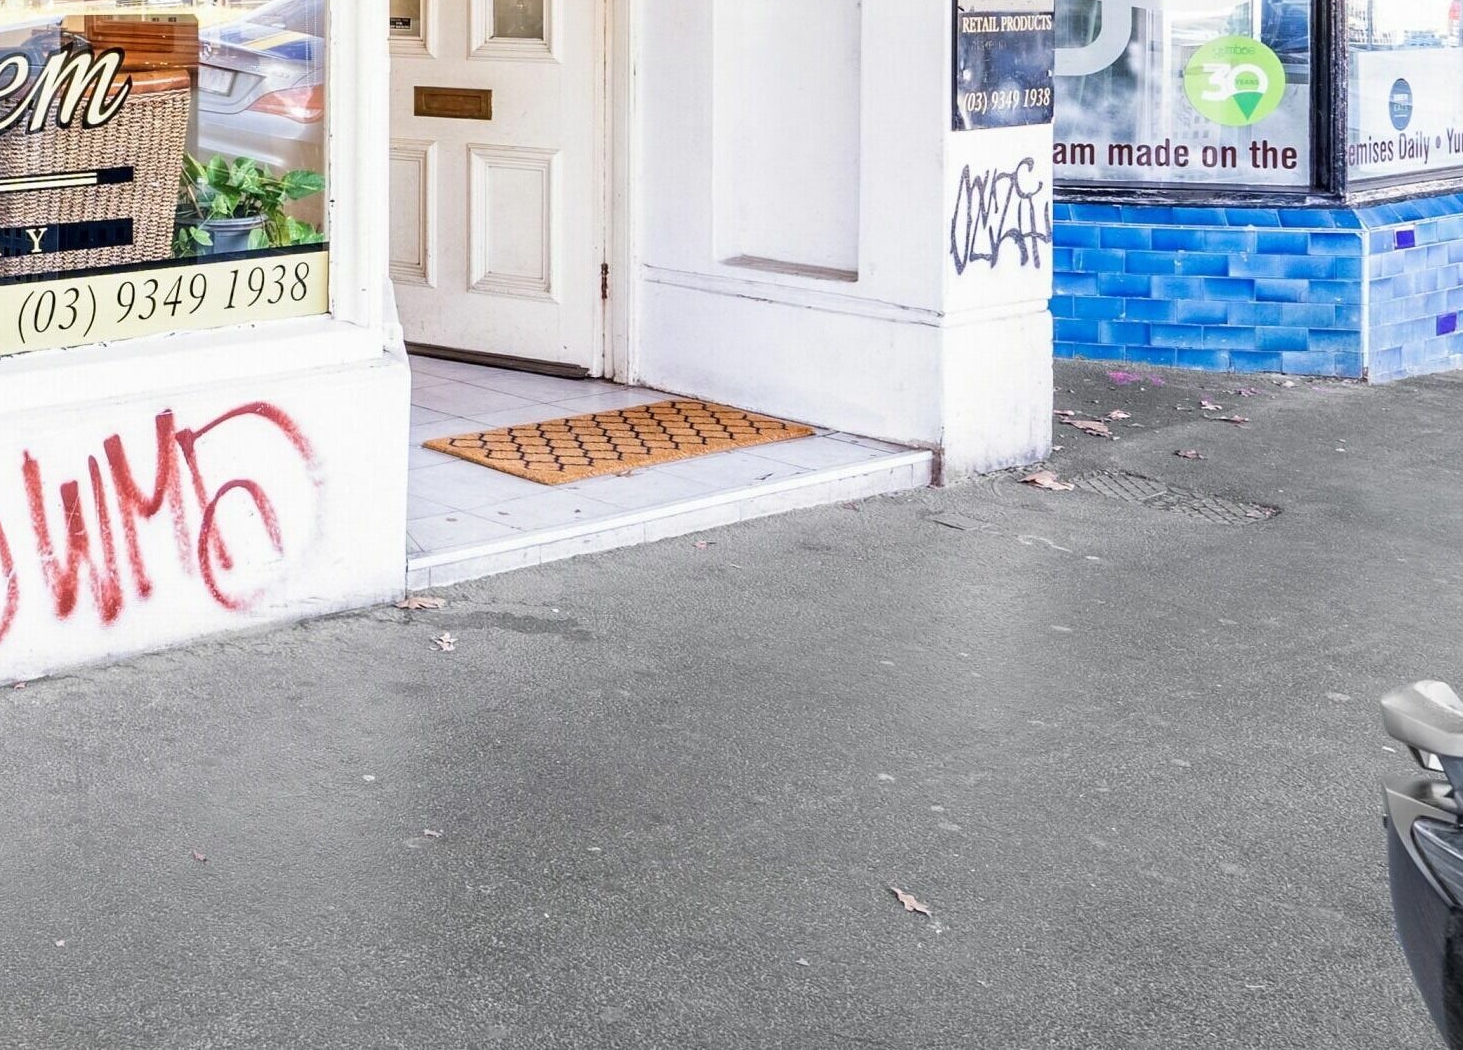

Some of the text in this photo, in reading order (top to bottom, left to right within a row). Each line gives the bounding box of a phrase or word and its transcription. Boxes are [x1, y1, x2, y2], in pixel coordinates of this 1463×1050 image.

[962, 14, 1052, 33] RETAIL PRODUCTS
[964, 87, 1051, 115] (03) 9349 1938
[1053, 138, 1298, 170] am made on the
[1399, 131, 1430, 165] Daily
[18, 261, 310, 344] (03) 9349 1938
